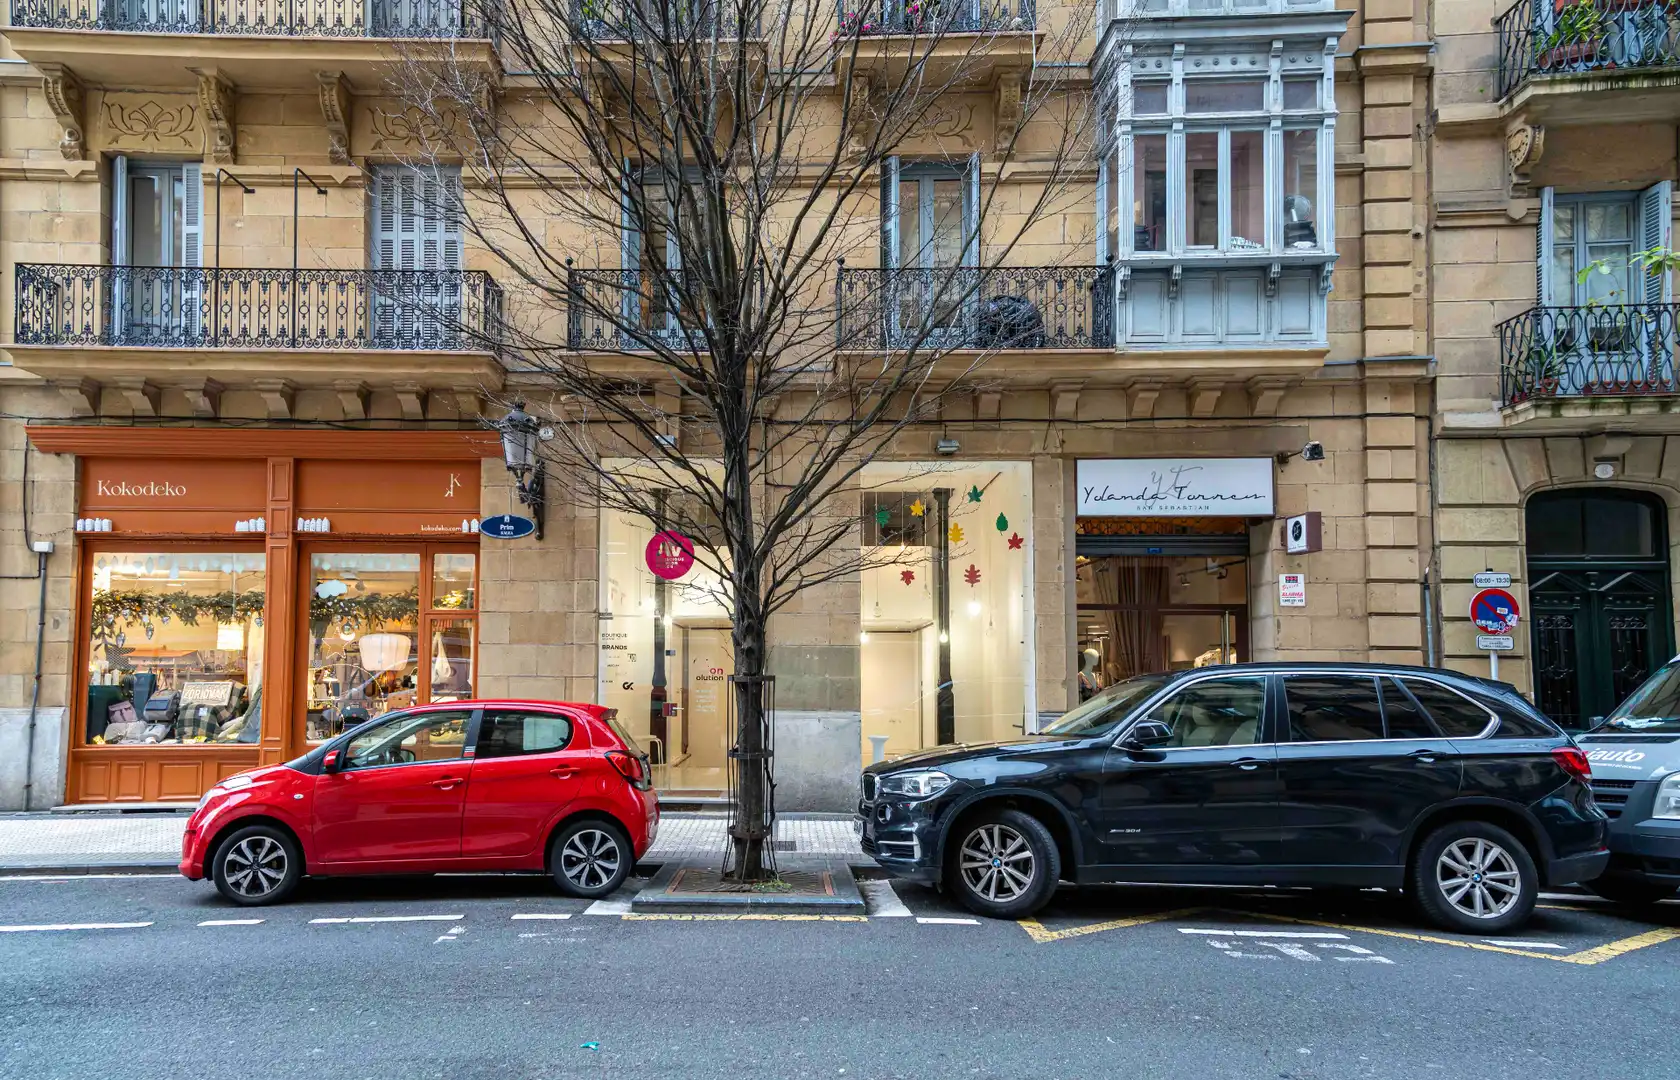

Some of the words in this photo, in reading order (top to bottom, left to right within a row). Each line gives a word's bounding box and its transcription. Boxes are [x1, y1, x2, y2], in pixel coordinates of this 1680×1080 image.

[97, 479, 187, 496] Kokodeko
[1083, 485, 1168, 504] Yolanda
[1173, 485, 1266, 501] Torres
[420, 524, 462, 532] kokodeko.com
